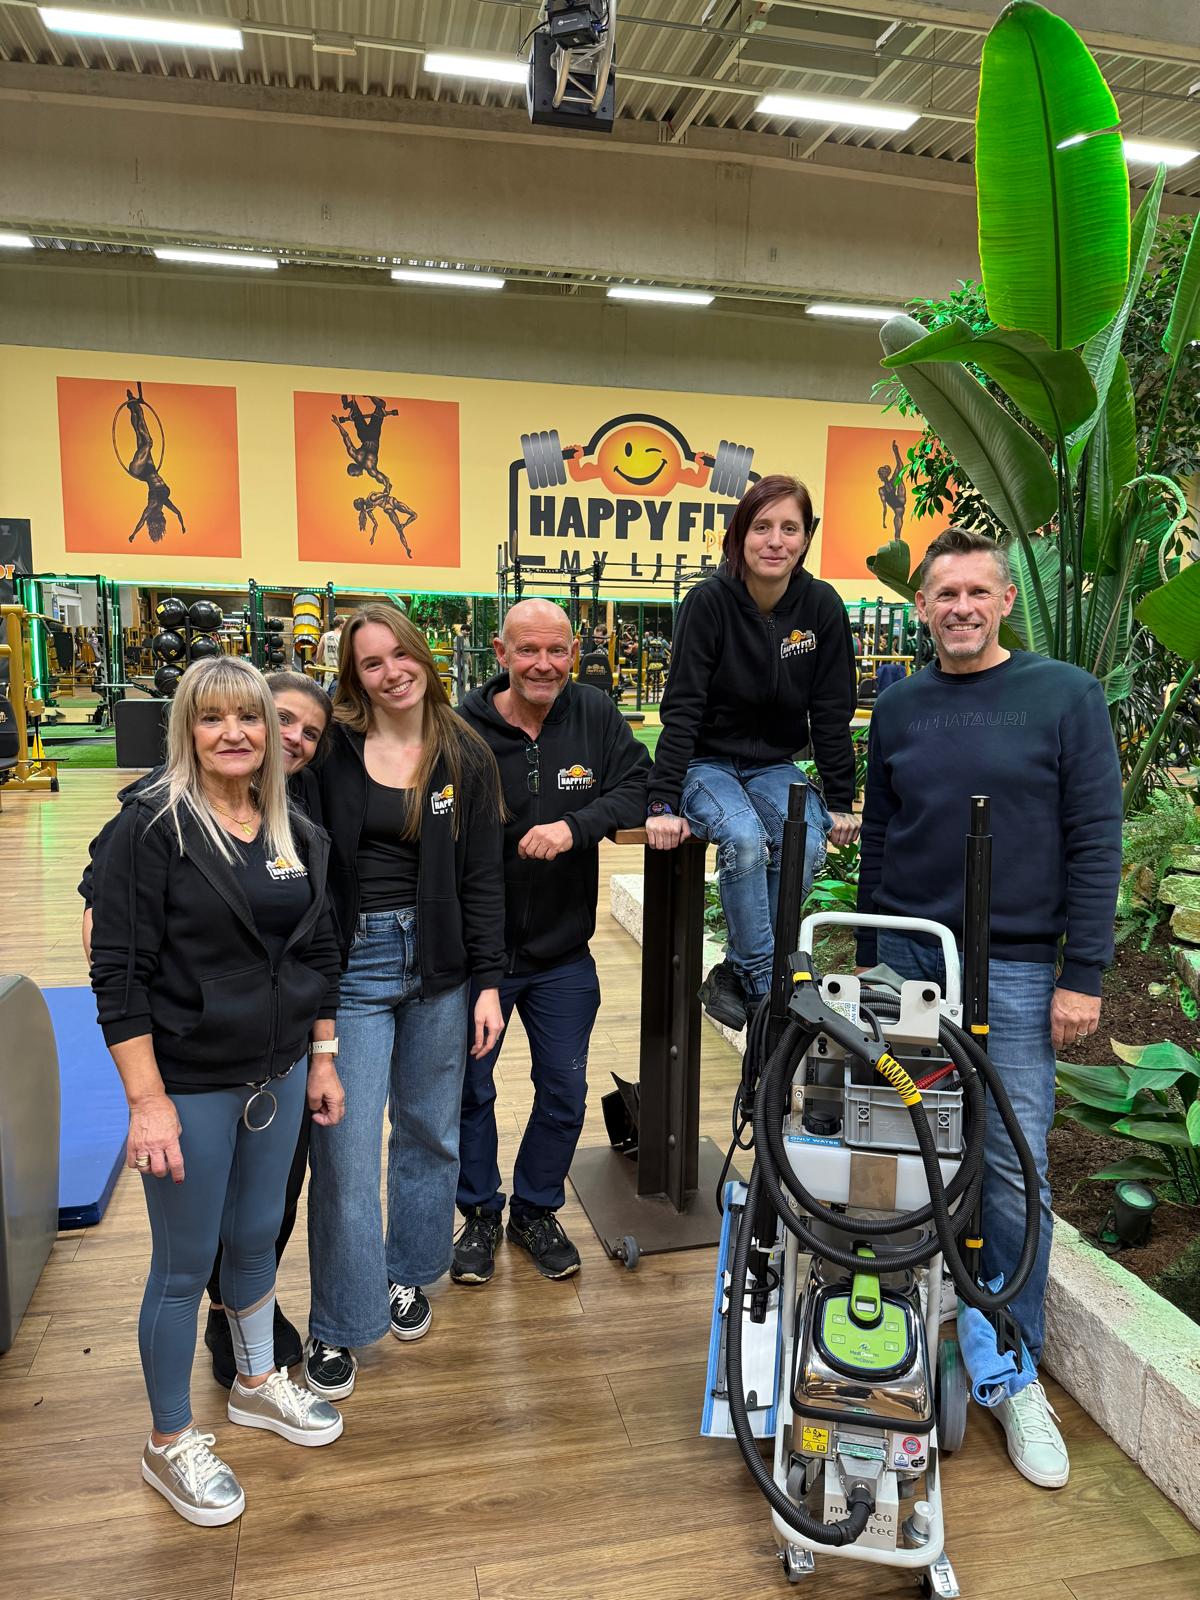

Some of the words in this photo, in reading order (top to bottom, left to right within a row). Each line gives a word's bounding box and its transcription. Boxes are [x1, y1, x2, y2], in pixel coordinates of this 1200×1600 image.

[529, 494, 672, 542] HAPPY
[560, 549, 609, 578] MY
[630, 551, 713, 578] LIFE
[434, 798, 454, 810] HAPP
[830, 1506, 892, 1522] mco
